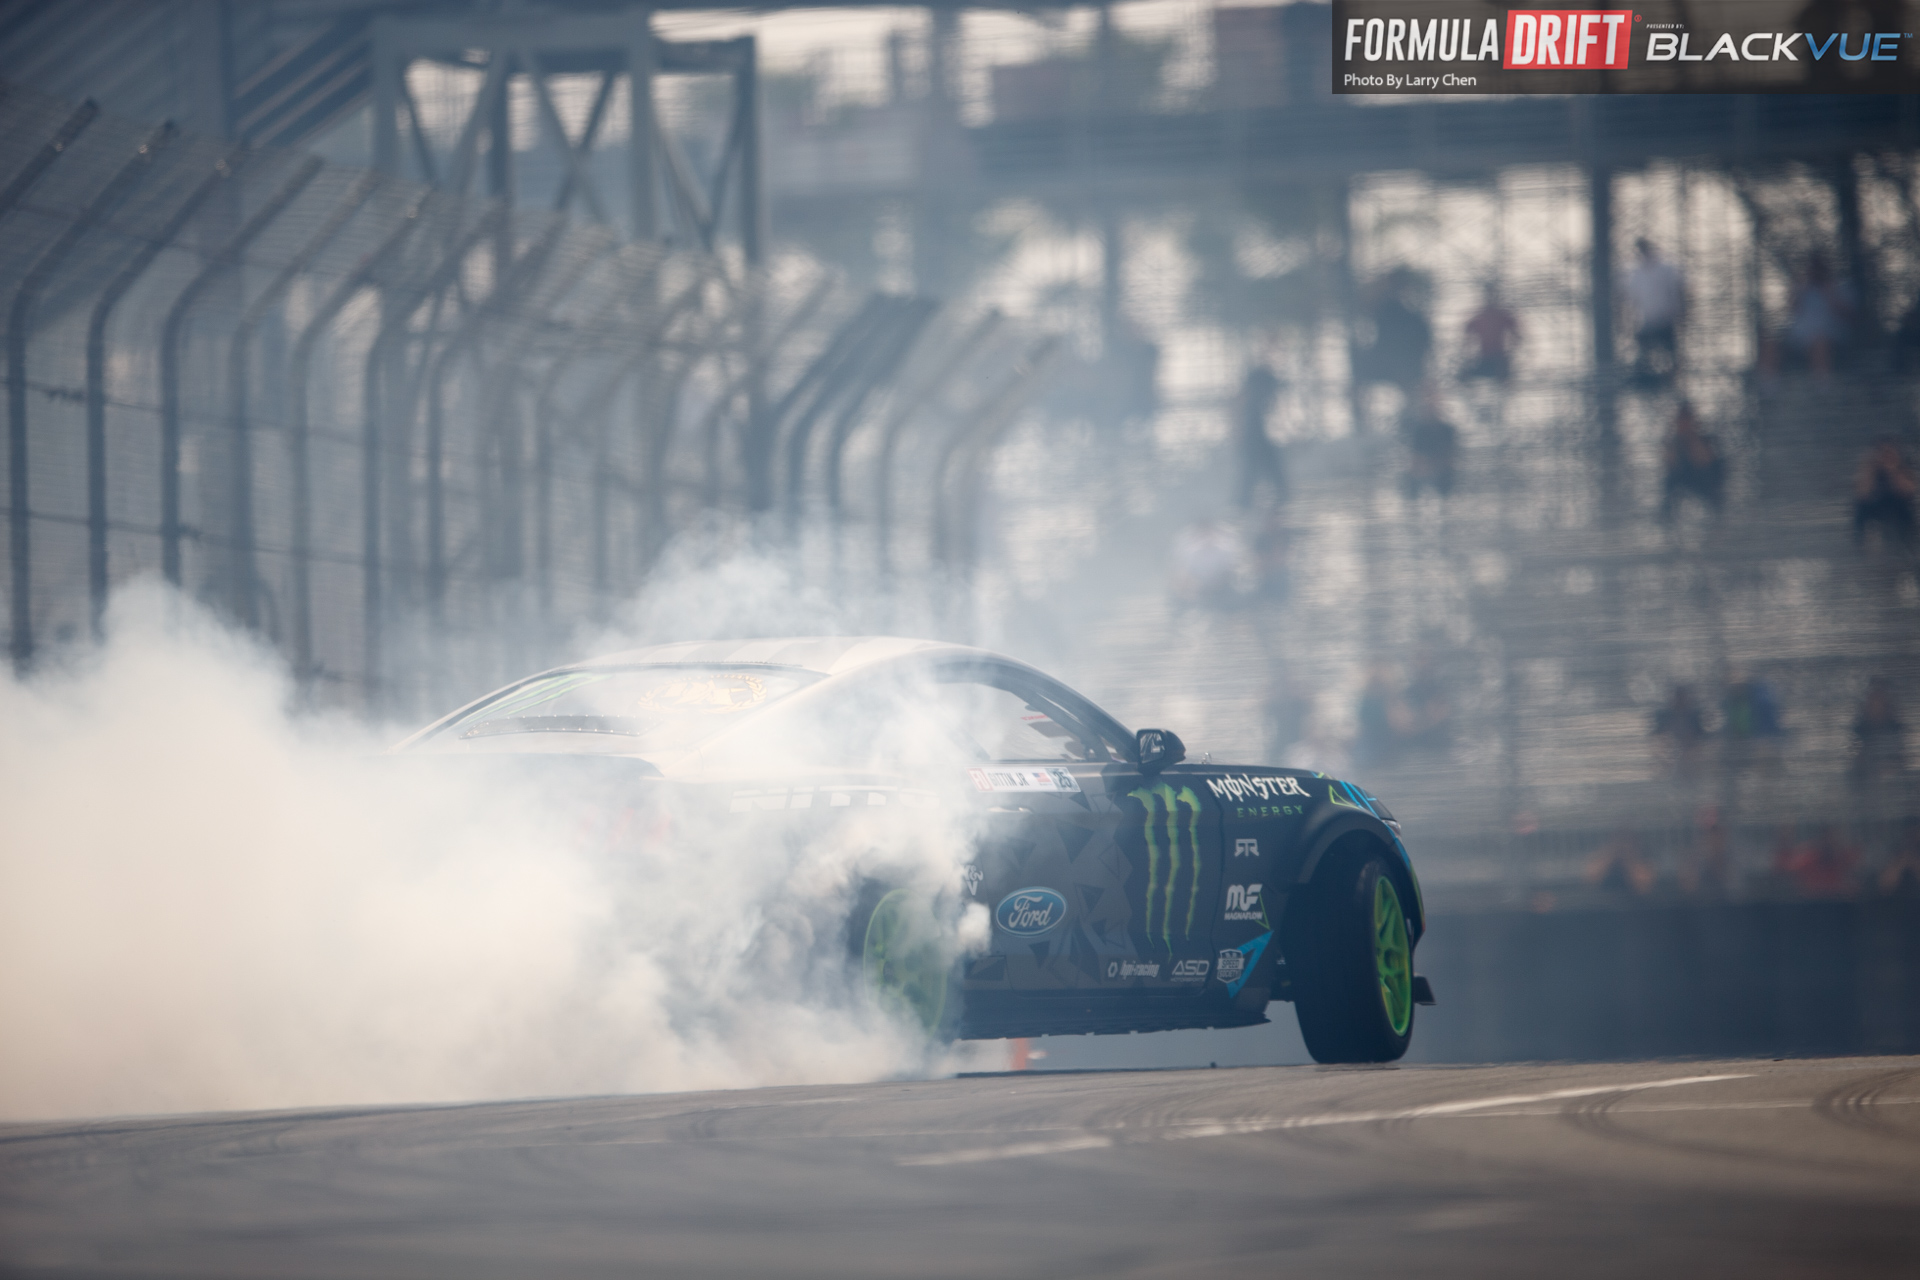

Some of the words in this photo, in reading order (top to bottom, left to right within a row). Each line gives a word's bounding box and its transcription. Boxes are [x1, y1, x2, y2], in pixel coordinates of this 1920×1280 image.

[1015, 772, 1030, 786] JR
[1053, 771, 1073, 788] 25
[1206, 773, 1312, 802] MONSTER
[1236, 805, 1304, 818] ENERGY
[1008, 895, 1054, 928] Ford
[1223, 911, 1264, 921] MAGNAFLOW
[1172, 960, 1210, 976] ASD
